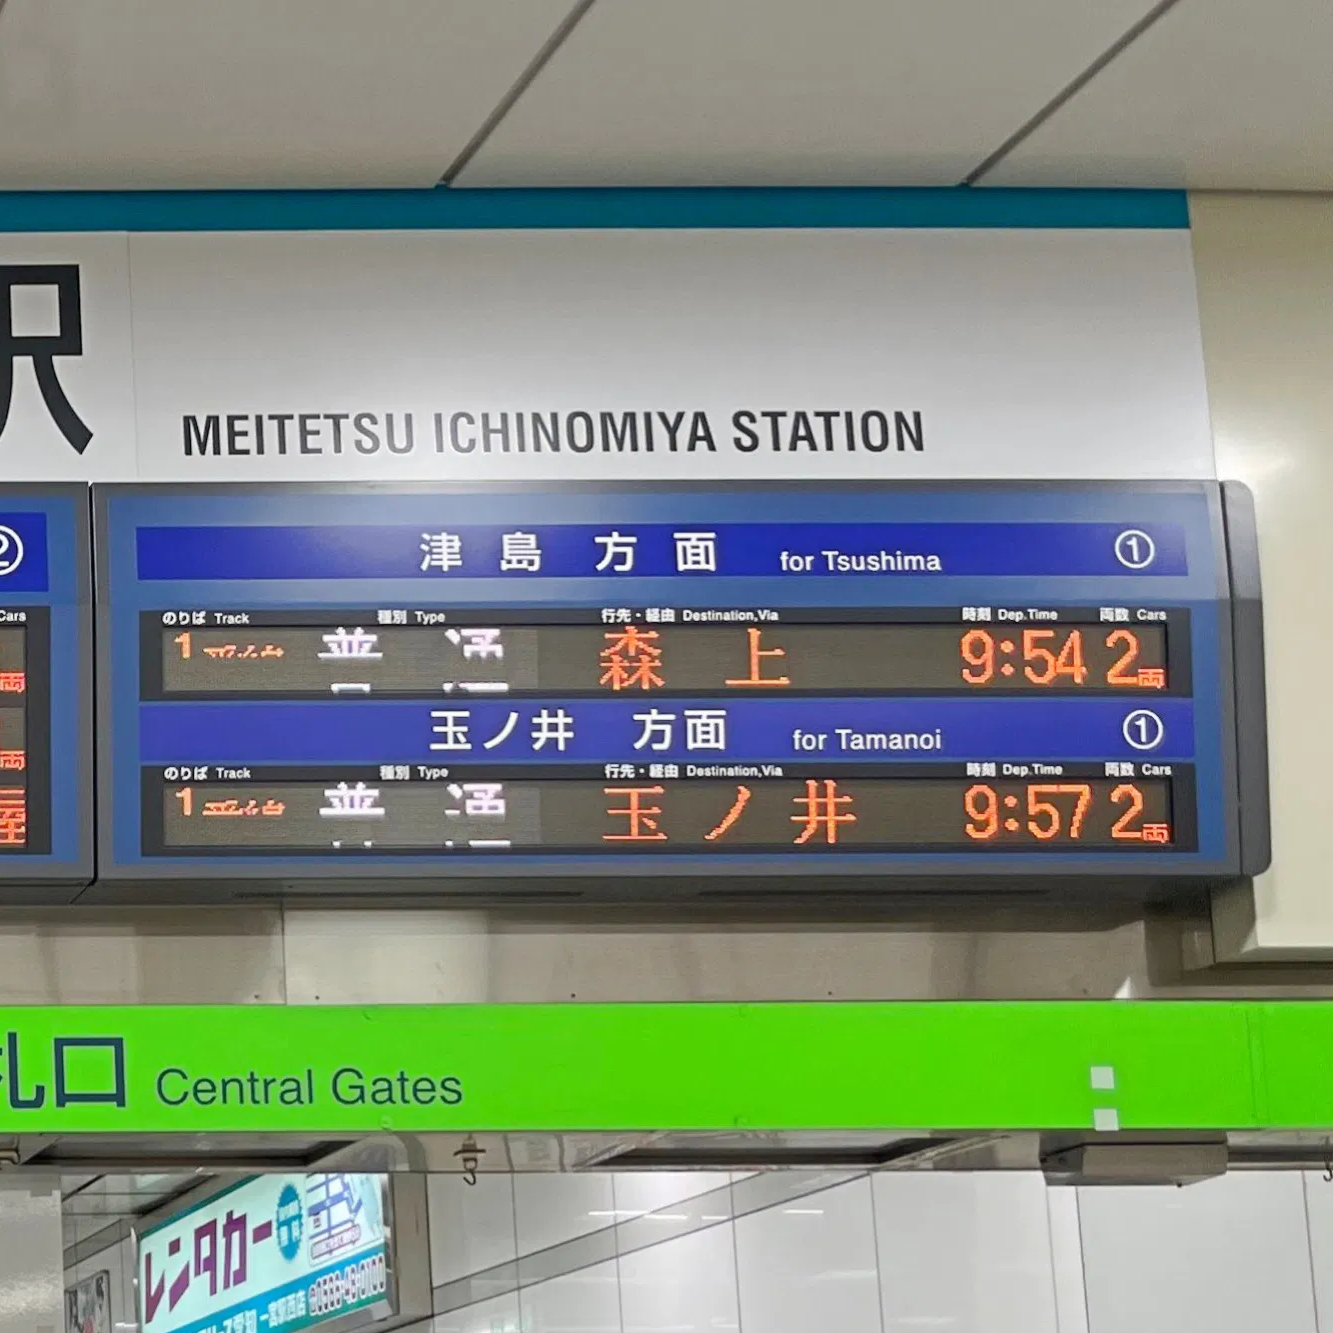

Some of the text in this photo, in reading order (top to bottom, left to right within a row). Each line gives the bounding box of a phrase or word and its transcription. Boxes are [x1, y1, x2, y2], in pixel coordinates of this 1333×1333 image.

[182, 409, 925, 458] MEITETSU ICHINOMIYA STATION
[419, 530, 942, 573] 津島 方面 for Tsushima
[162, 610, 206, 625] のりば
[214, 612, 250, 625] Track
[377, 609, 407, 625] 種別
[414, 610, 446, 626] Type
[962, 607, 992, 623] 時刻
[997, 608, 1059, 623] Dep.Time
[1100, 606, 1130, 622] 両数
[1137, 608, 1167, 622] Cars
[599, 627, 1088, 690] 森上 9:54
[429, 709, 942, 751] 玉ノ井 方面 for Tamanoi
[164, 765, 209, 780] のりば
[216, 767, 251, 780] Track
[380, 765, 410, 780] 種別
[418, 766, 449, 782] Type
[966, 762, 997, 778] 時刻
[1002, 763, 1063, 779] Dep.Time
[1104, 762, 1135, 778] 両数
[1142, 763, 1172, 777] Cars
[602, 780, 1094, 844] 玉ノ井 9:57
[155, 1067, 314, 1107] Central
[331, 1067, 463, 1108] Gates
[145, 1210, 272, 1325] レンタカー
